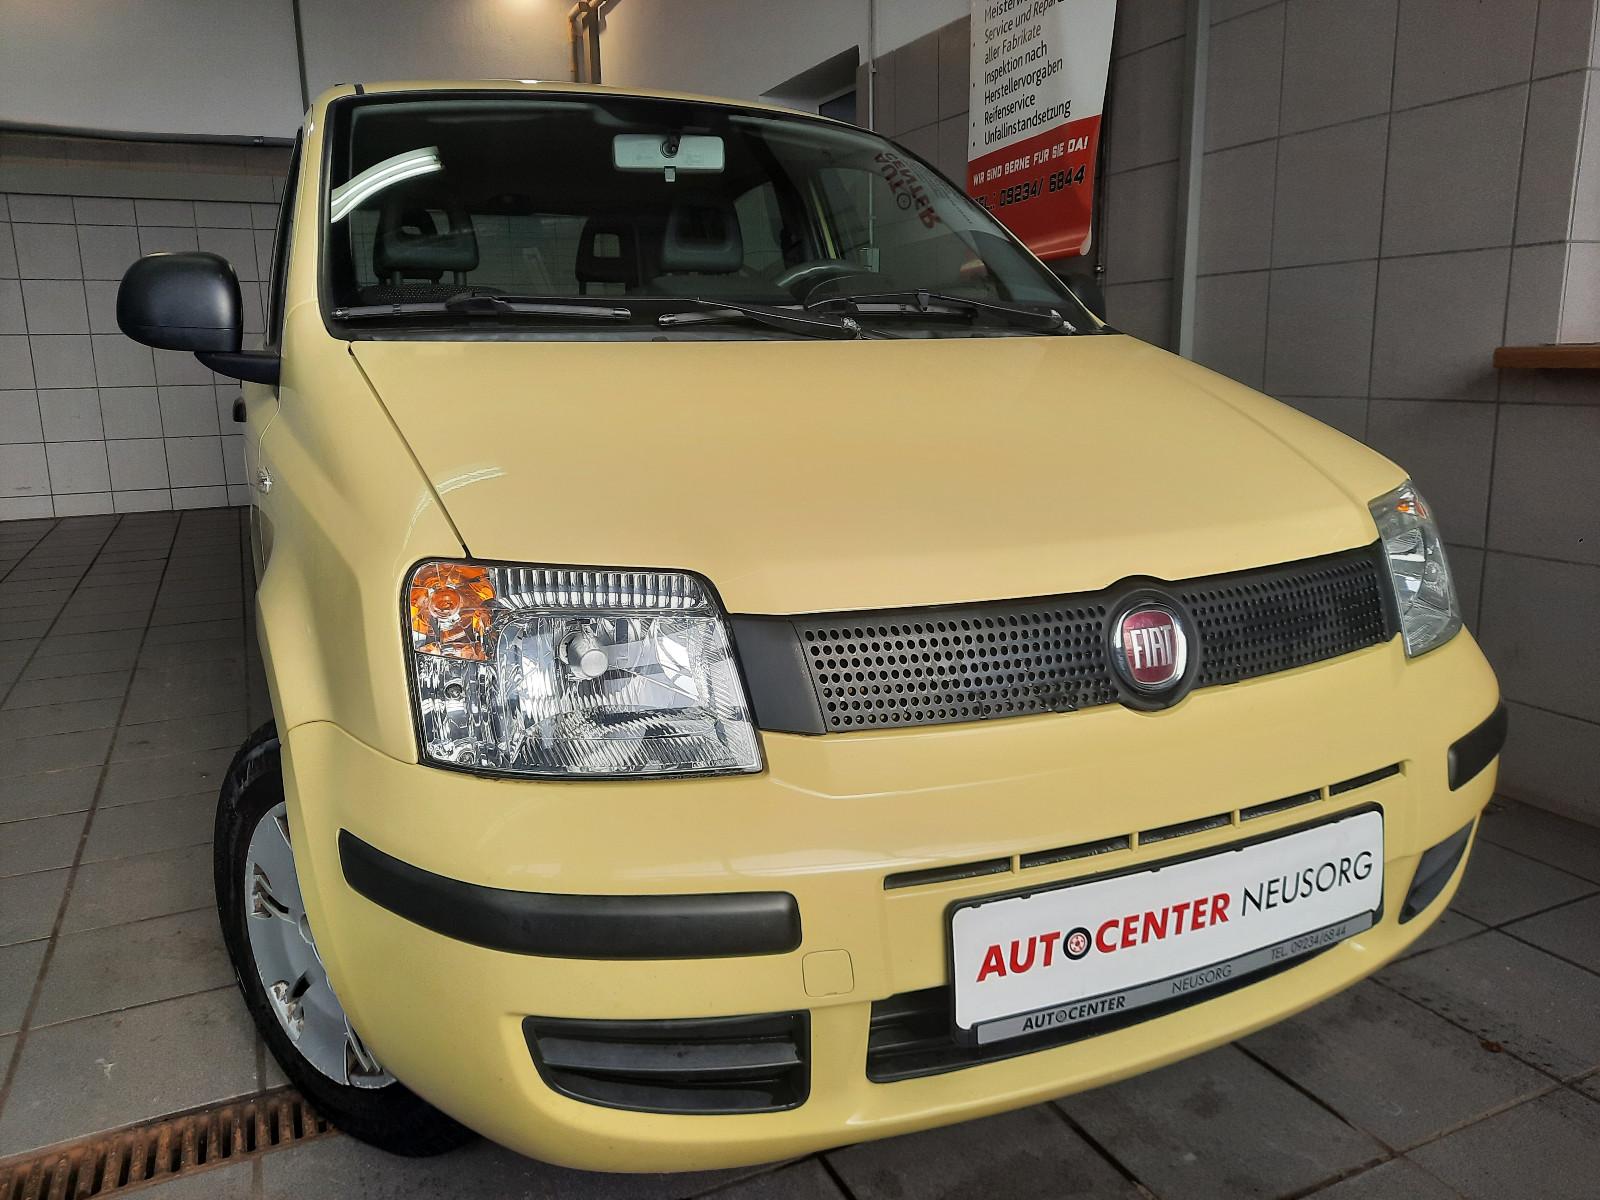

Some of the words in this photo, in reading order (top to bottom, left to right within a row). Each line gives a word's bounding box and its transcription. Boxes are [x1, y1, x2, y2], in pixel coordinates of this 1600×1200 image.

[985, 0, 1028, 22] Meisterw
[985, 19, 1013, 43] Service
[1015, 5, 1032, 28] und
[984, 56, 1023, 85] Inspektion
[1025, 40, 1048, 64] nach
[985, 46, 1001, 64] aller
[1002, 24, 1042, 55] Fabrikate
[984, 58, 1063, 105] Herstellervorgaben
[984, 94, 1036, 125] Reifenservice
[984, 99, 1072, 146] Unfallinstandsetzung
[973, 171, 985, 187] WIR
[986, 164, 1003, 181] SIND
[1004, 155, 1031, 175] GERNE
[1051, 142, 1065, 159] SIE
[1067, 135, 1089, 154] DA!
[1048, 164, 1086, 194] 6844
[1129, 624, 1172, 670] FIAT
[976, 892, 1231, 983] AUTOCENTER
[1241, 851, 1373, 917] NEUSORG
[1022, 995, 1126, 1032] AUTOCENTER
[1171, 964, 1232, 994] NEUSORG
